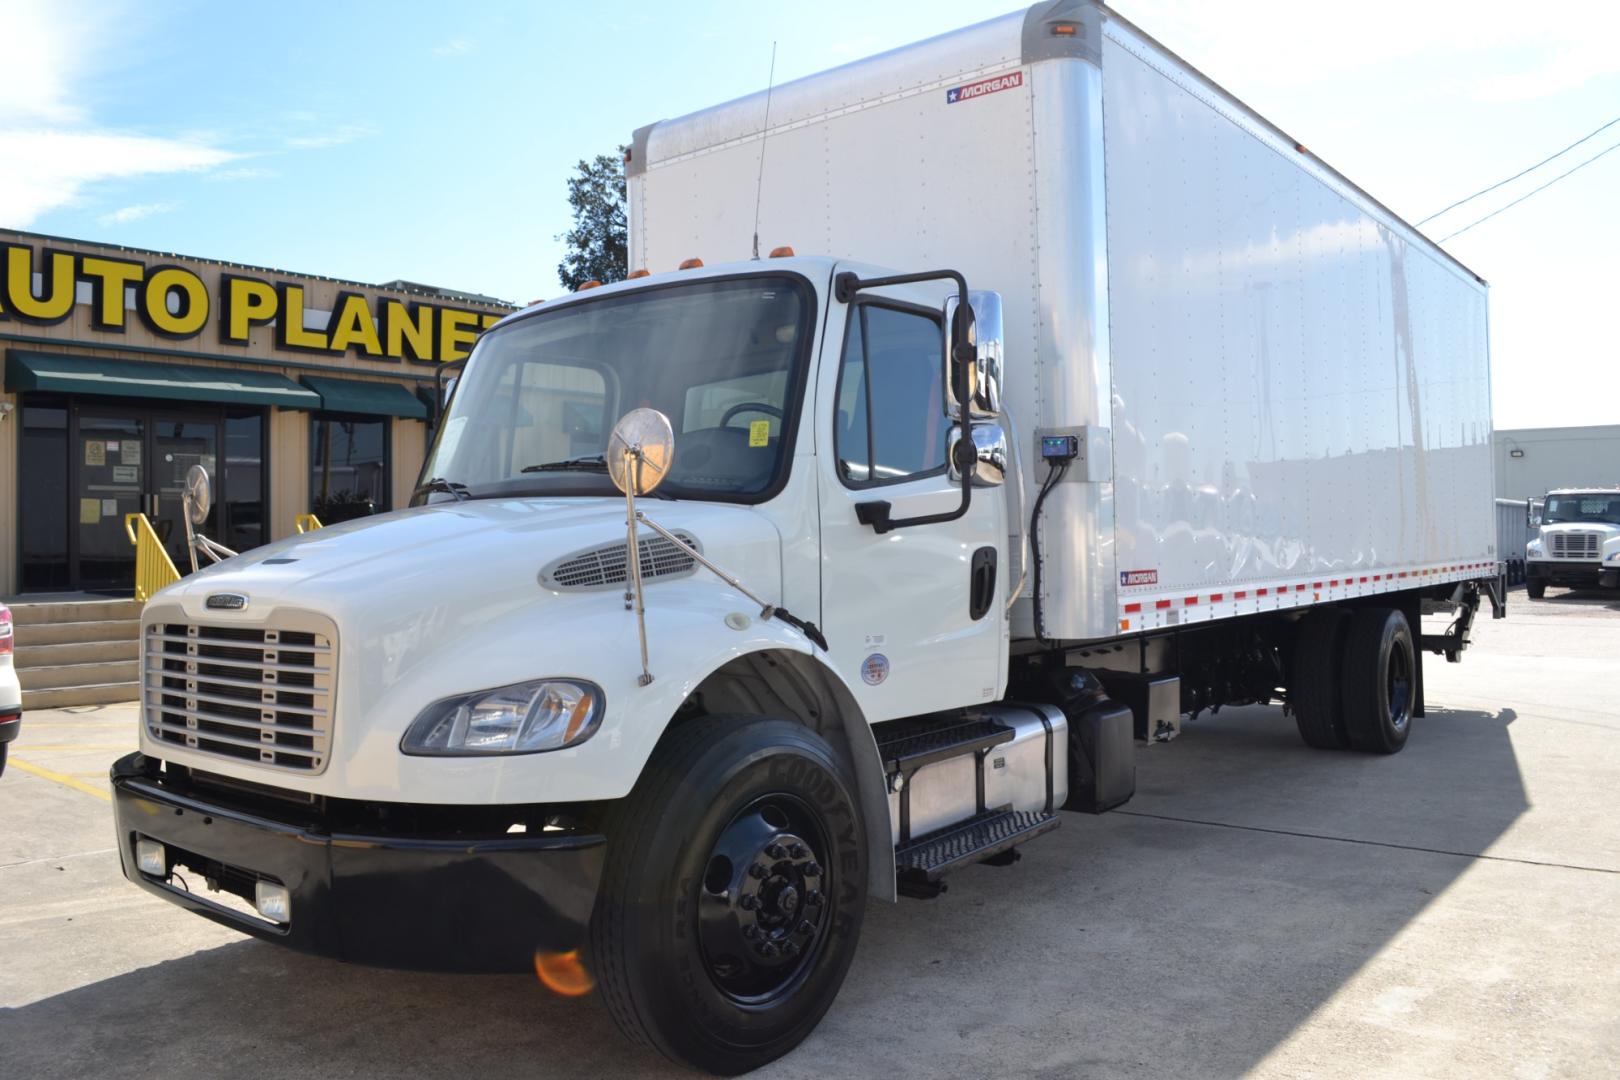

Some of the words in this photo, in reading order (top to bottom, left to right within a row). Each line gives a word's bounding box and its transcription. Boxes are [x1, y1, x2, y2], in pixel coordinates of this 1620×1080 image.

[960, 74, 1020, 99] MORGAN
[0, 245, 210, 336] UTO
[1127, 571, 1157, 585] MORGAN
